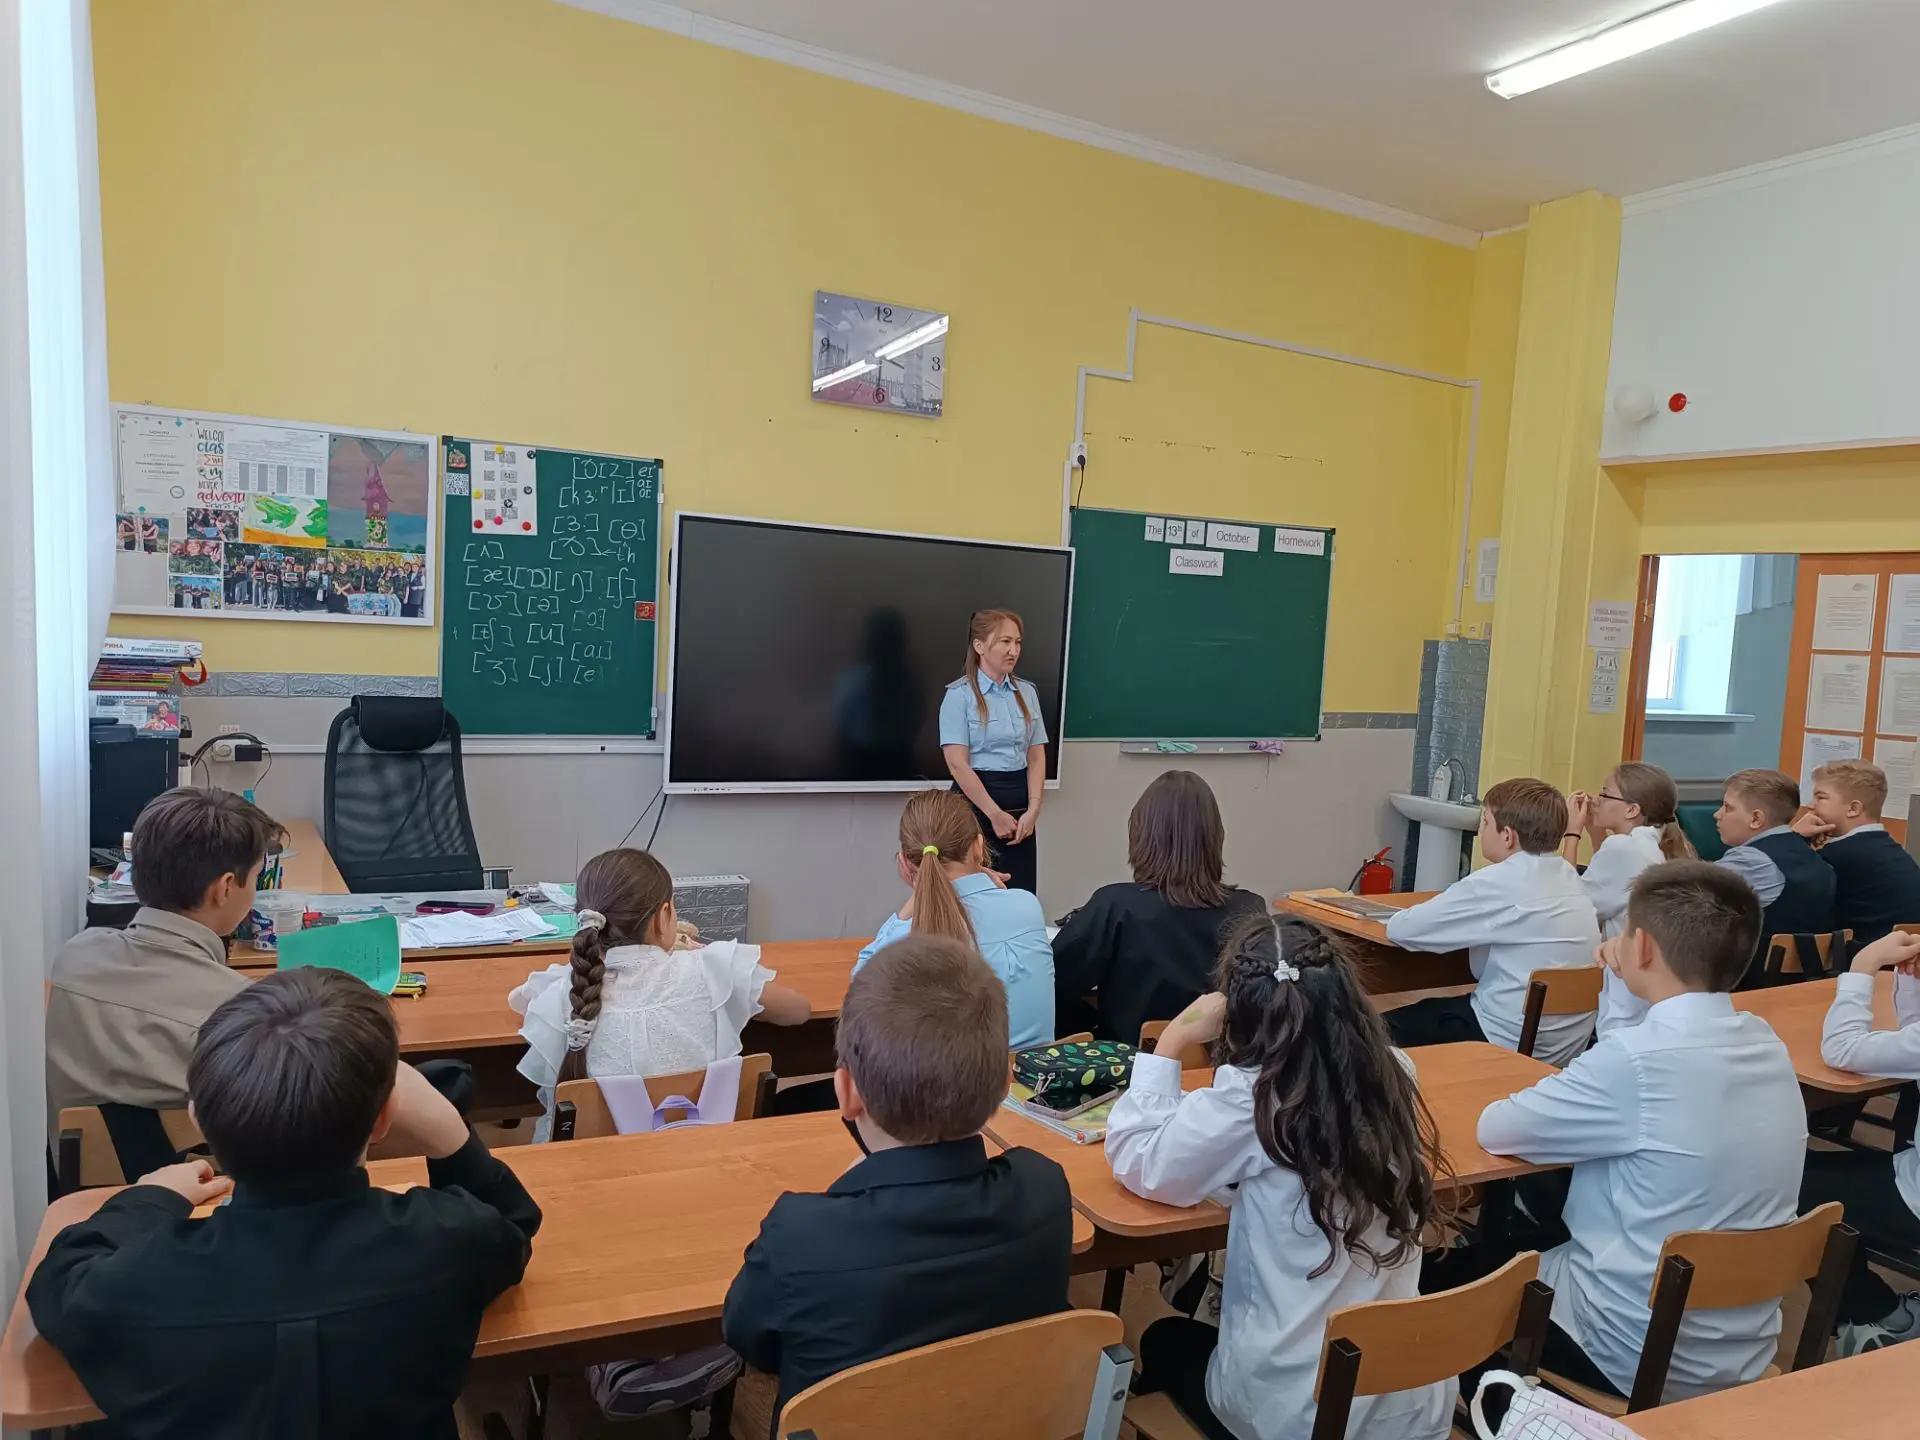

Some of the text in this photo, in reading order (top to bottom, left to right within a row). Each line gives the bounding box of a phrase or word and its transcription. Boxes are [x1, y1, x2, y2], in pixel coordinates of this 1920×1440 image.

[875, 306, 892, 323] 12
[821, 337, 830, 351] 9
[932, 356, 941, 371] 3
[873, 387, 885, 404] 6
[1147, 524, 1251, 544] The 13th of October
[1278, 534, 1322, 549] Homework
[1175, 555, 1219, 569] Classwork
